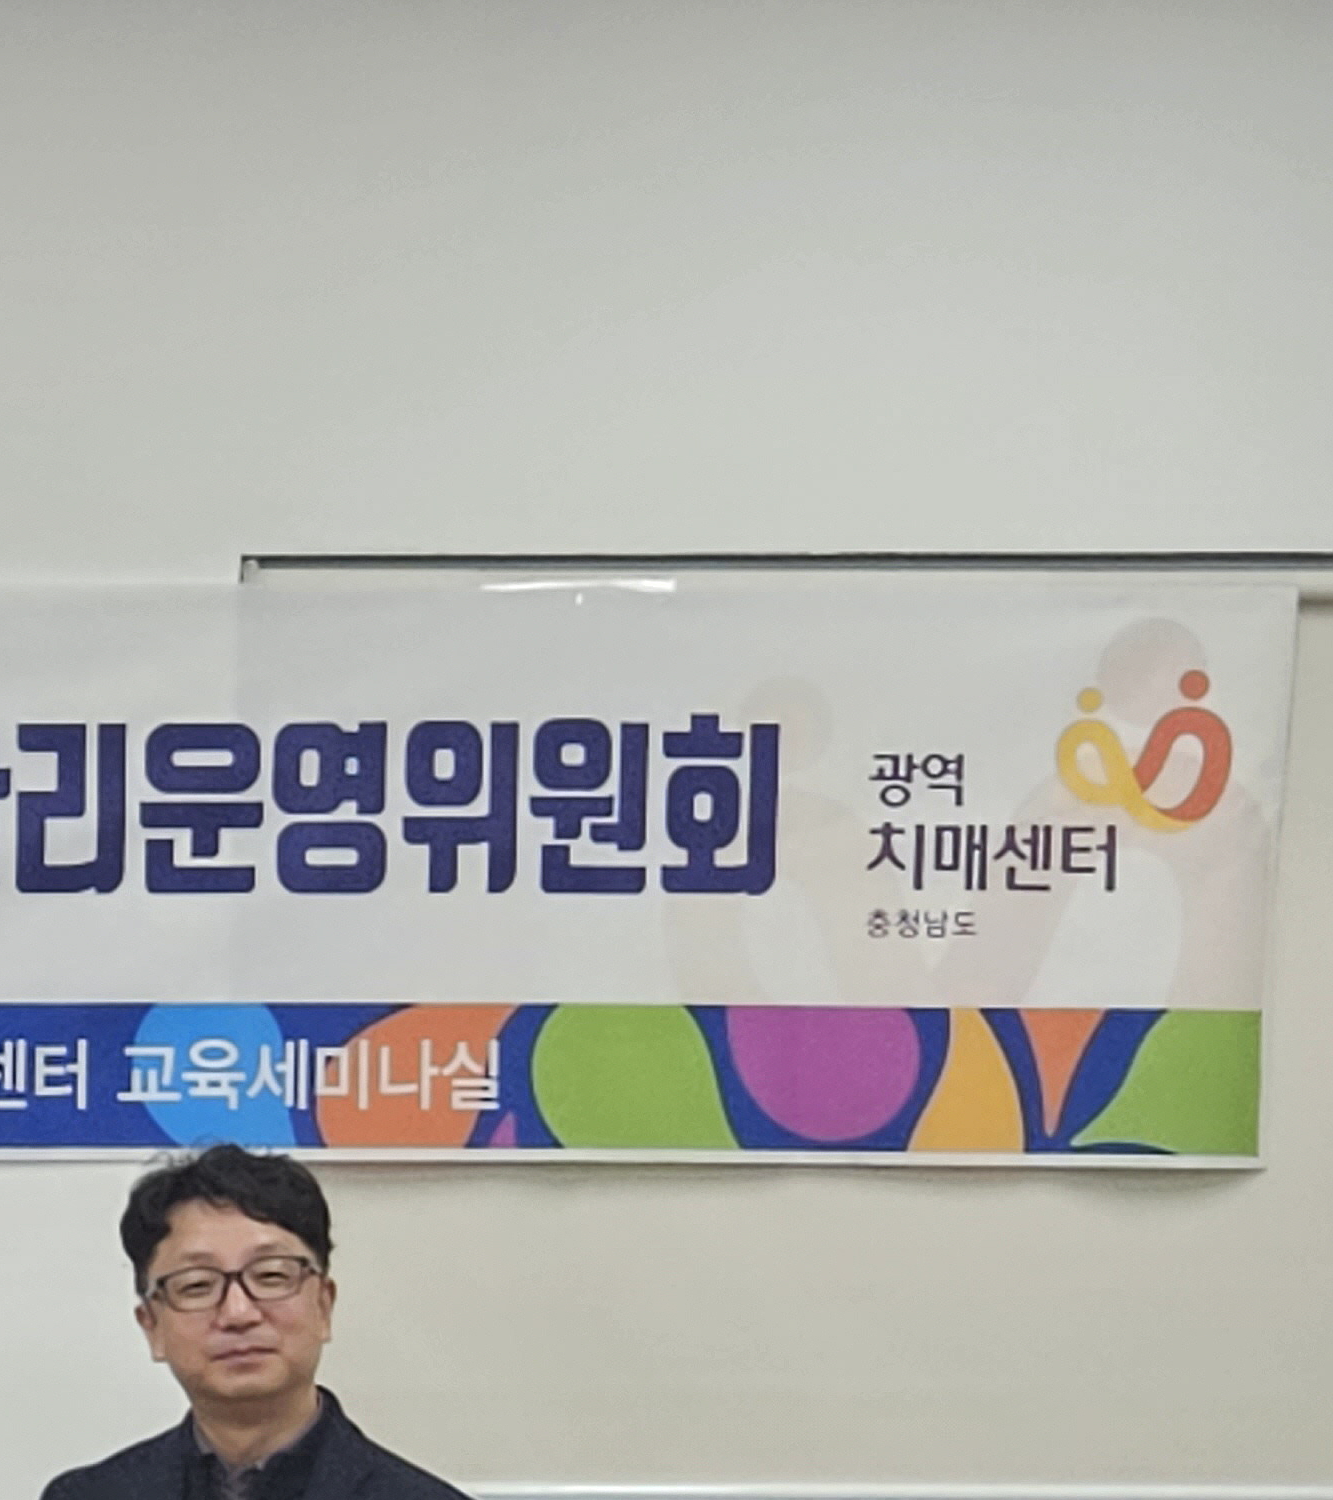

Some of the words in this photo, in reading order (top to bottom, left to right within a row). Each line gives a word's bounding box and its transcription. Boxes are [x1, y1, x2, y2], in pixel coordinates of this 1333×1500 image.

[868, 753, 965, 808] 광역
[866, 821, 1117, 892] 치매센터
[867, 908, 978, 939] 충청남도
[117, 1038, 501, 1111] 교육세미나실
